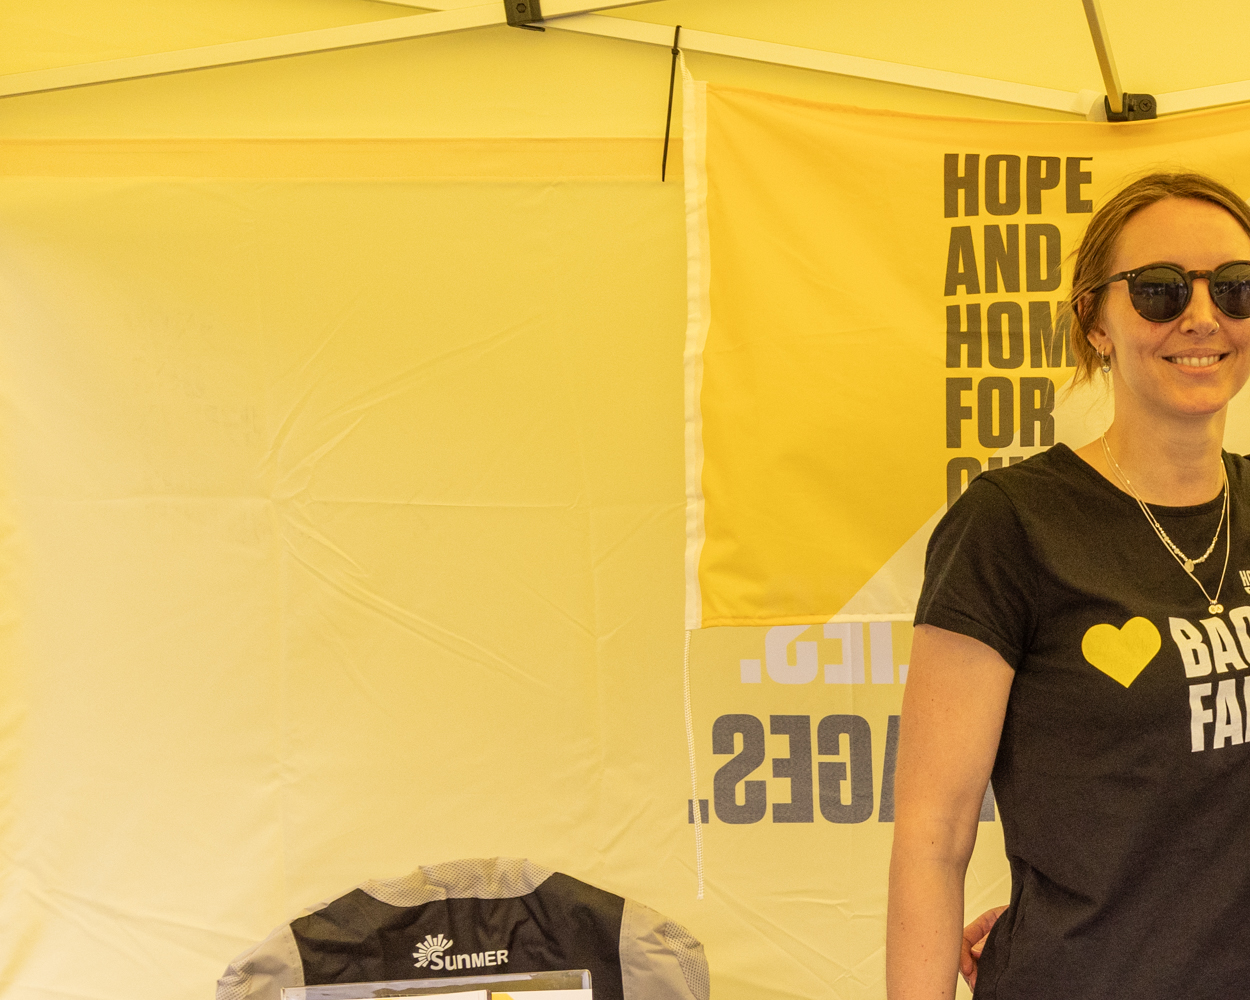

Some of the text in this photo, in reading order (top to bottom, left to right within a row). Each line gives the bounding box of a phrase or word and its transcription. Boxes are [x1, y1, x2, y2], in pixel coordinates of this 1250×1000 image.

[944, 153, 1093, 218] HOPE
[944, 224, 1061, 296] AND
[946, 376, 1055, 448] FOR
